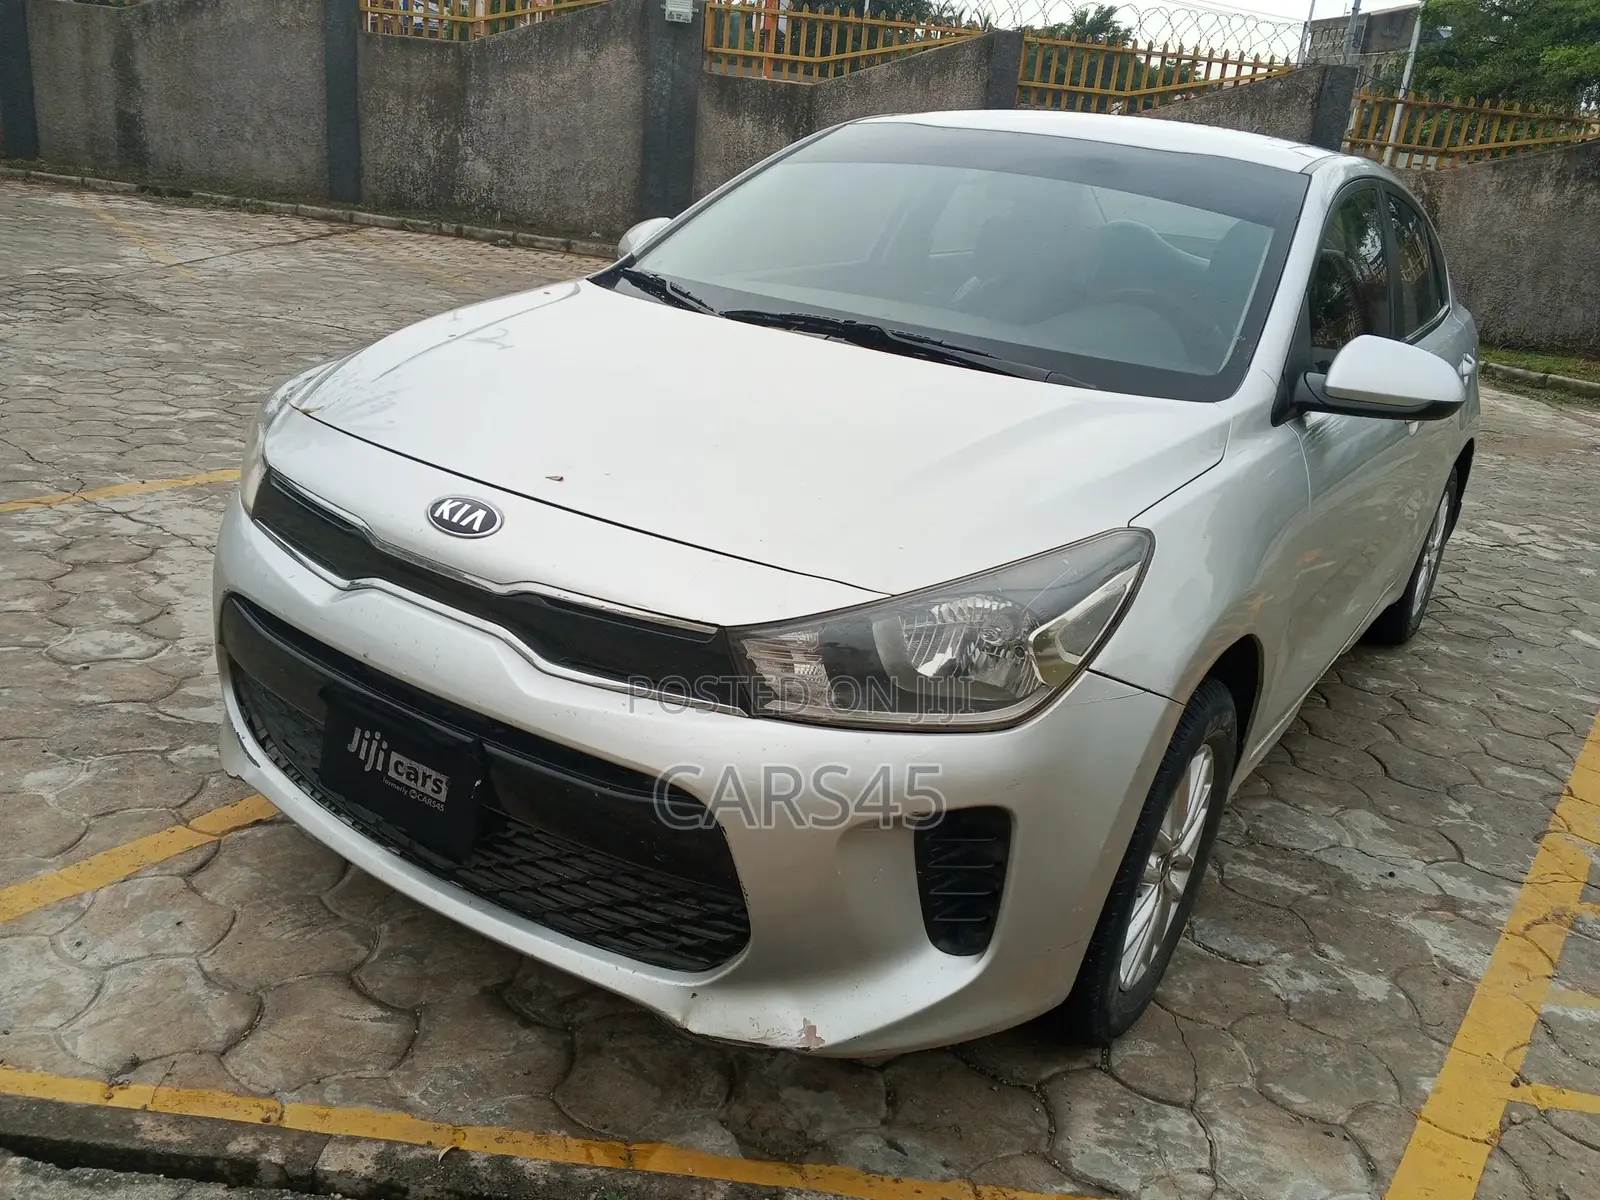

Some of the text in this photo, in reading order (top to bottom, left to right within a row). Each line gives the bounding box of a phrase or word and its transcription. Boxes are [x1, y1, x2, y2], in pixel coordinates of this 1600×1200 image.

[433, 499, 487, 532] KIA
[347, 727, 444, 795] Jiji cars
[382, 775, 445, 812] formerly CARS45
